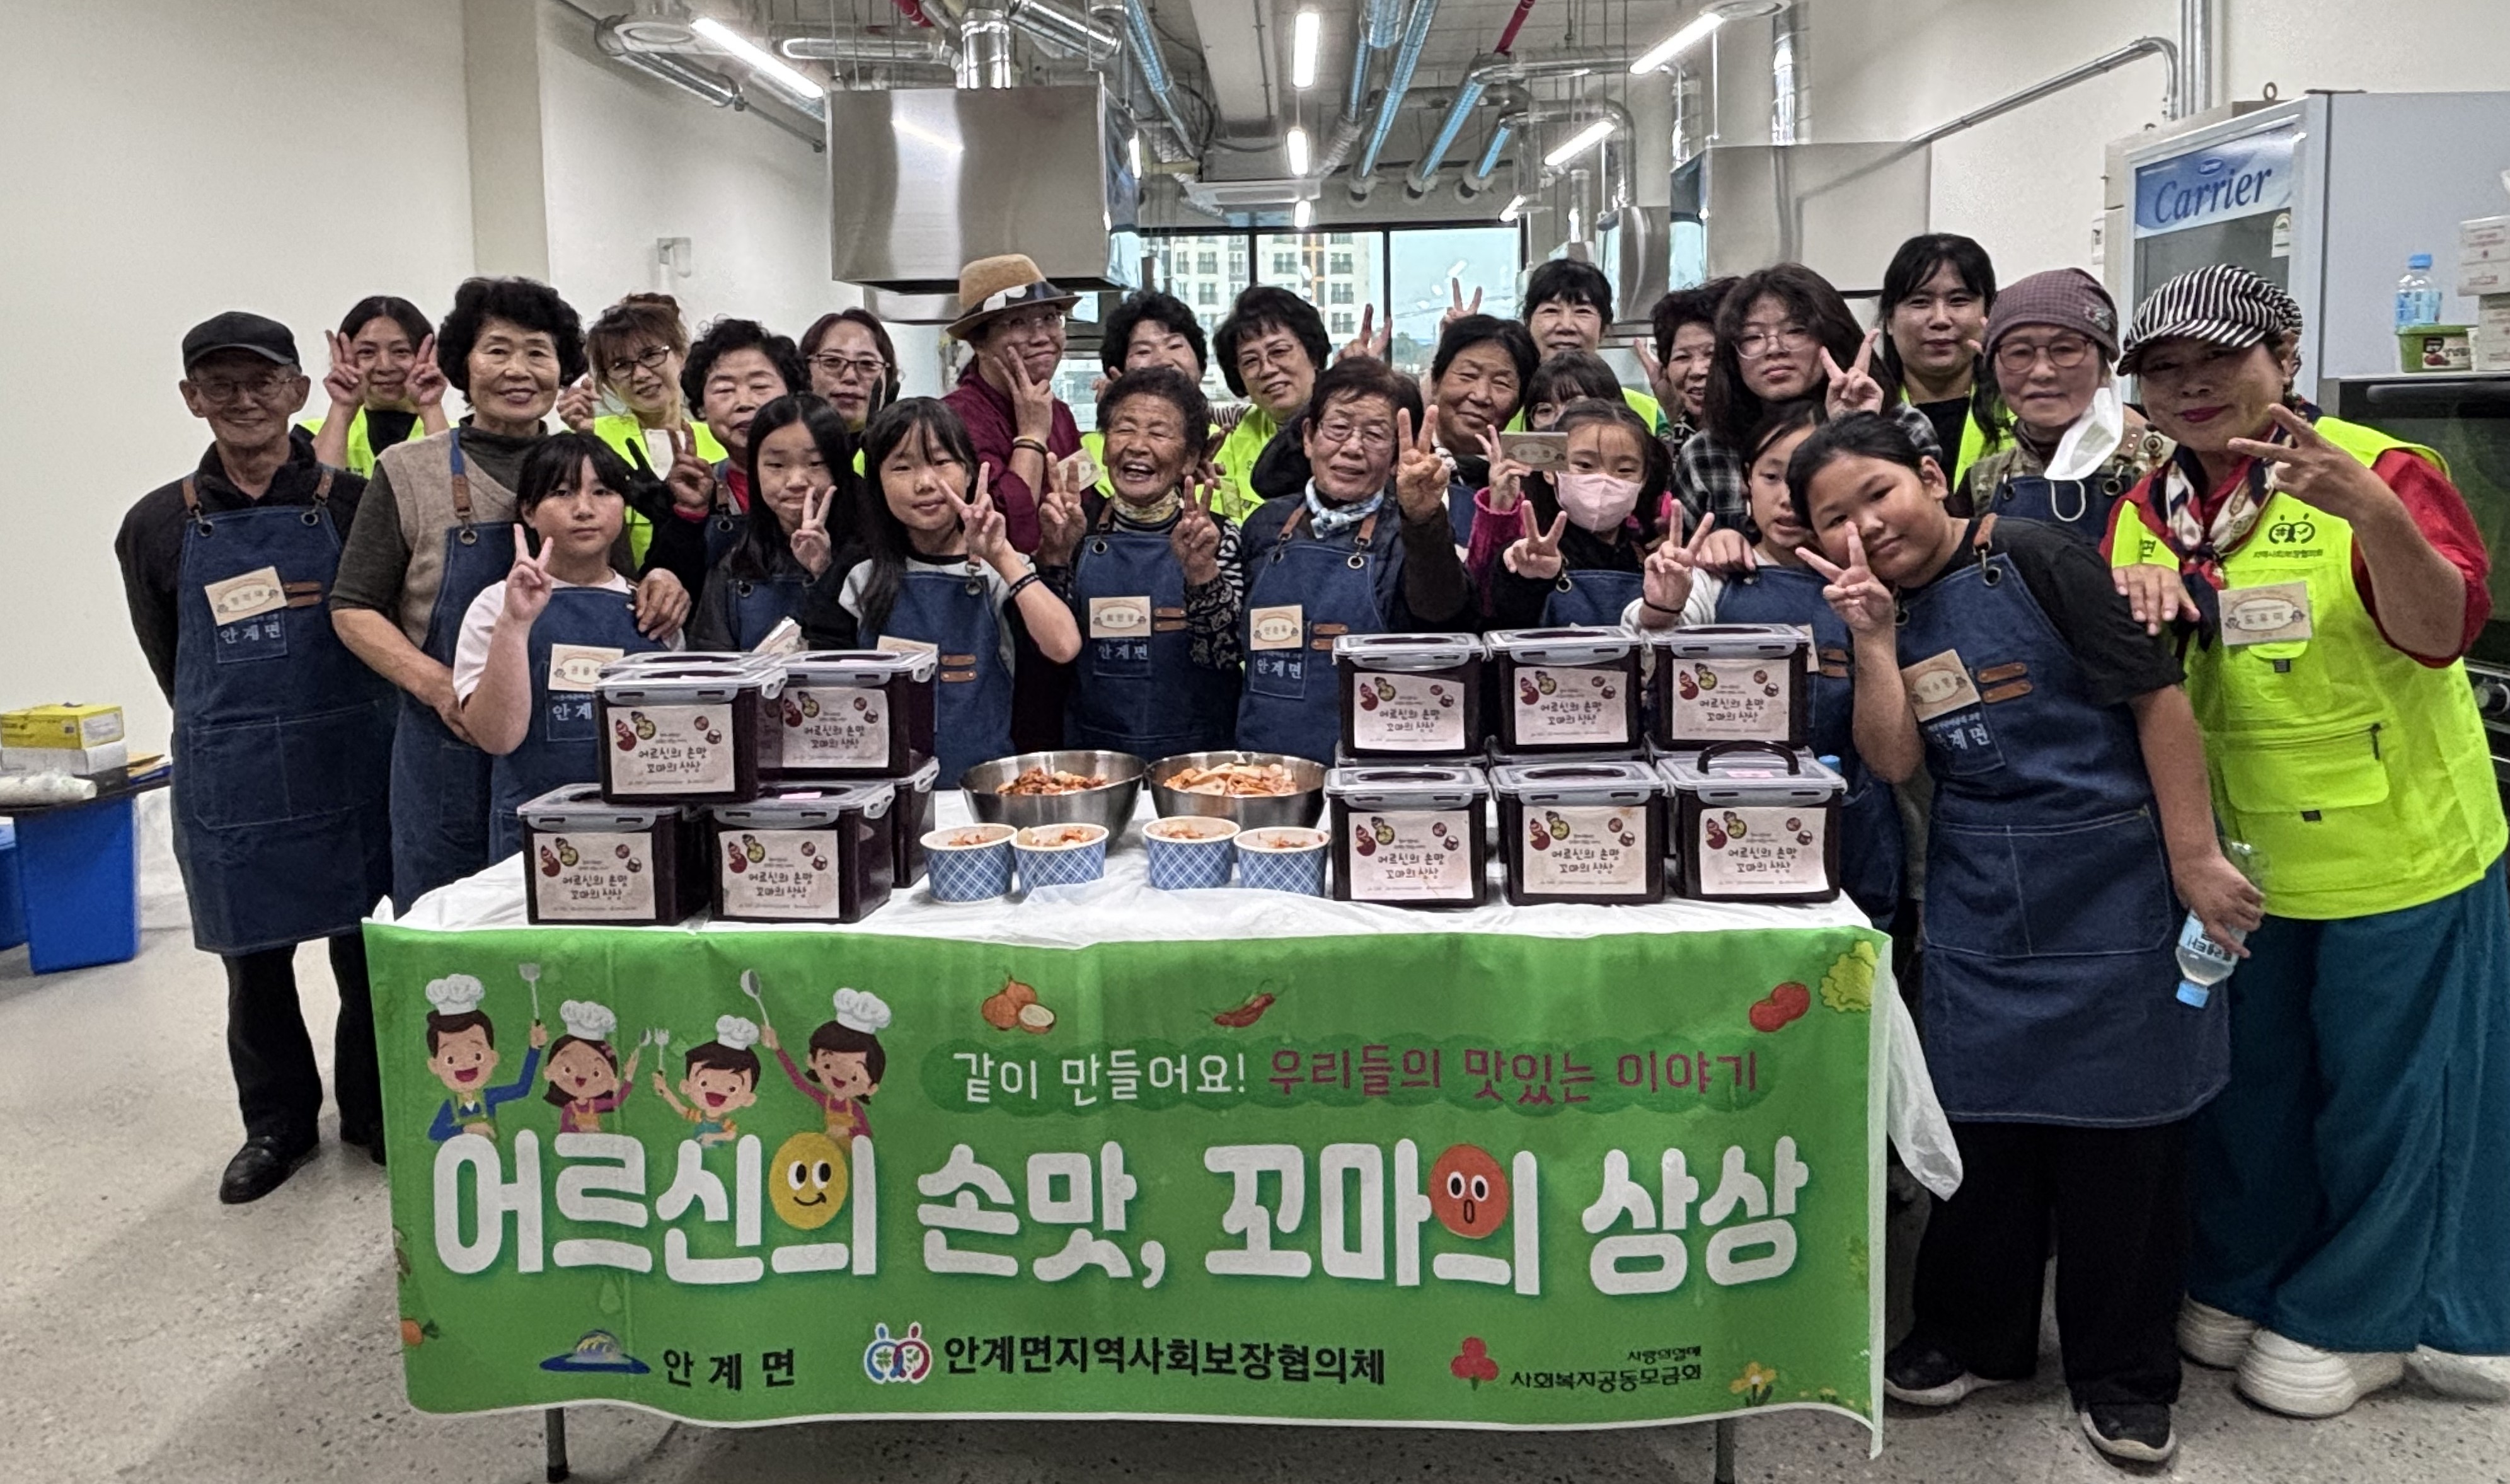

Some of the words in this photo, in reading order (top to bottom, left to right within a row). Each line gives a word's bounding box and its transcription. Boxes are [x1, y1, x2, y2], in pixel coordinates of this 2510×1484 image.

[2155, 168, 2272, 223] Carrier
[221, 621, 281, 644] 안계면
[1098, 643, 1149, 660] 안계면
[1257, 657, 1302, 679] 안계면
[552, 701, 592, 721] 안계
[1540, 701, 1579, 713] 어르신의
[1700, 698, 1741, 710] 어르신의
[1379, 708, 1418, 720] 어르신의
[804, 725, 842, 737] 어르신의
[638, 747, 682, 759] 어르신의
[1378, 853, 1419, 865] 어르신의
[1551, 848, 1594, 860] 어르신의
[1728, 847, 1771, 859] 어르신의
[563, 874, 604, 887] 어르신의
[748, 871, 789, 884] 어르신의
[953, 1052, 1038, 1103] 같이
[1061, 1049, 1246, 1107] 만들어요!
[1268, 1043, 1441, 1097] 우리들의
[1463, 1047, 1596, 1107] 맛있는
[1616, 1049, 1758, 1095] 이야기
[432, 1129, 877, 1284] 어르신의
[917, 1139, 1166, 1288] 손맛,
[1204, 1137, 1541, 1296] 꼬마의
[1581, 1134, 1809, 1296] 상상
[945, 1335, 1386, 1385] 안계면지역사회보장협의체
[663, 1347, 795, 1391] 안계면
[1511, 1364, 1701, 1394] 사회복지공동모금회
